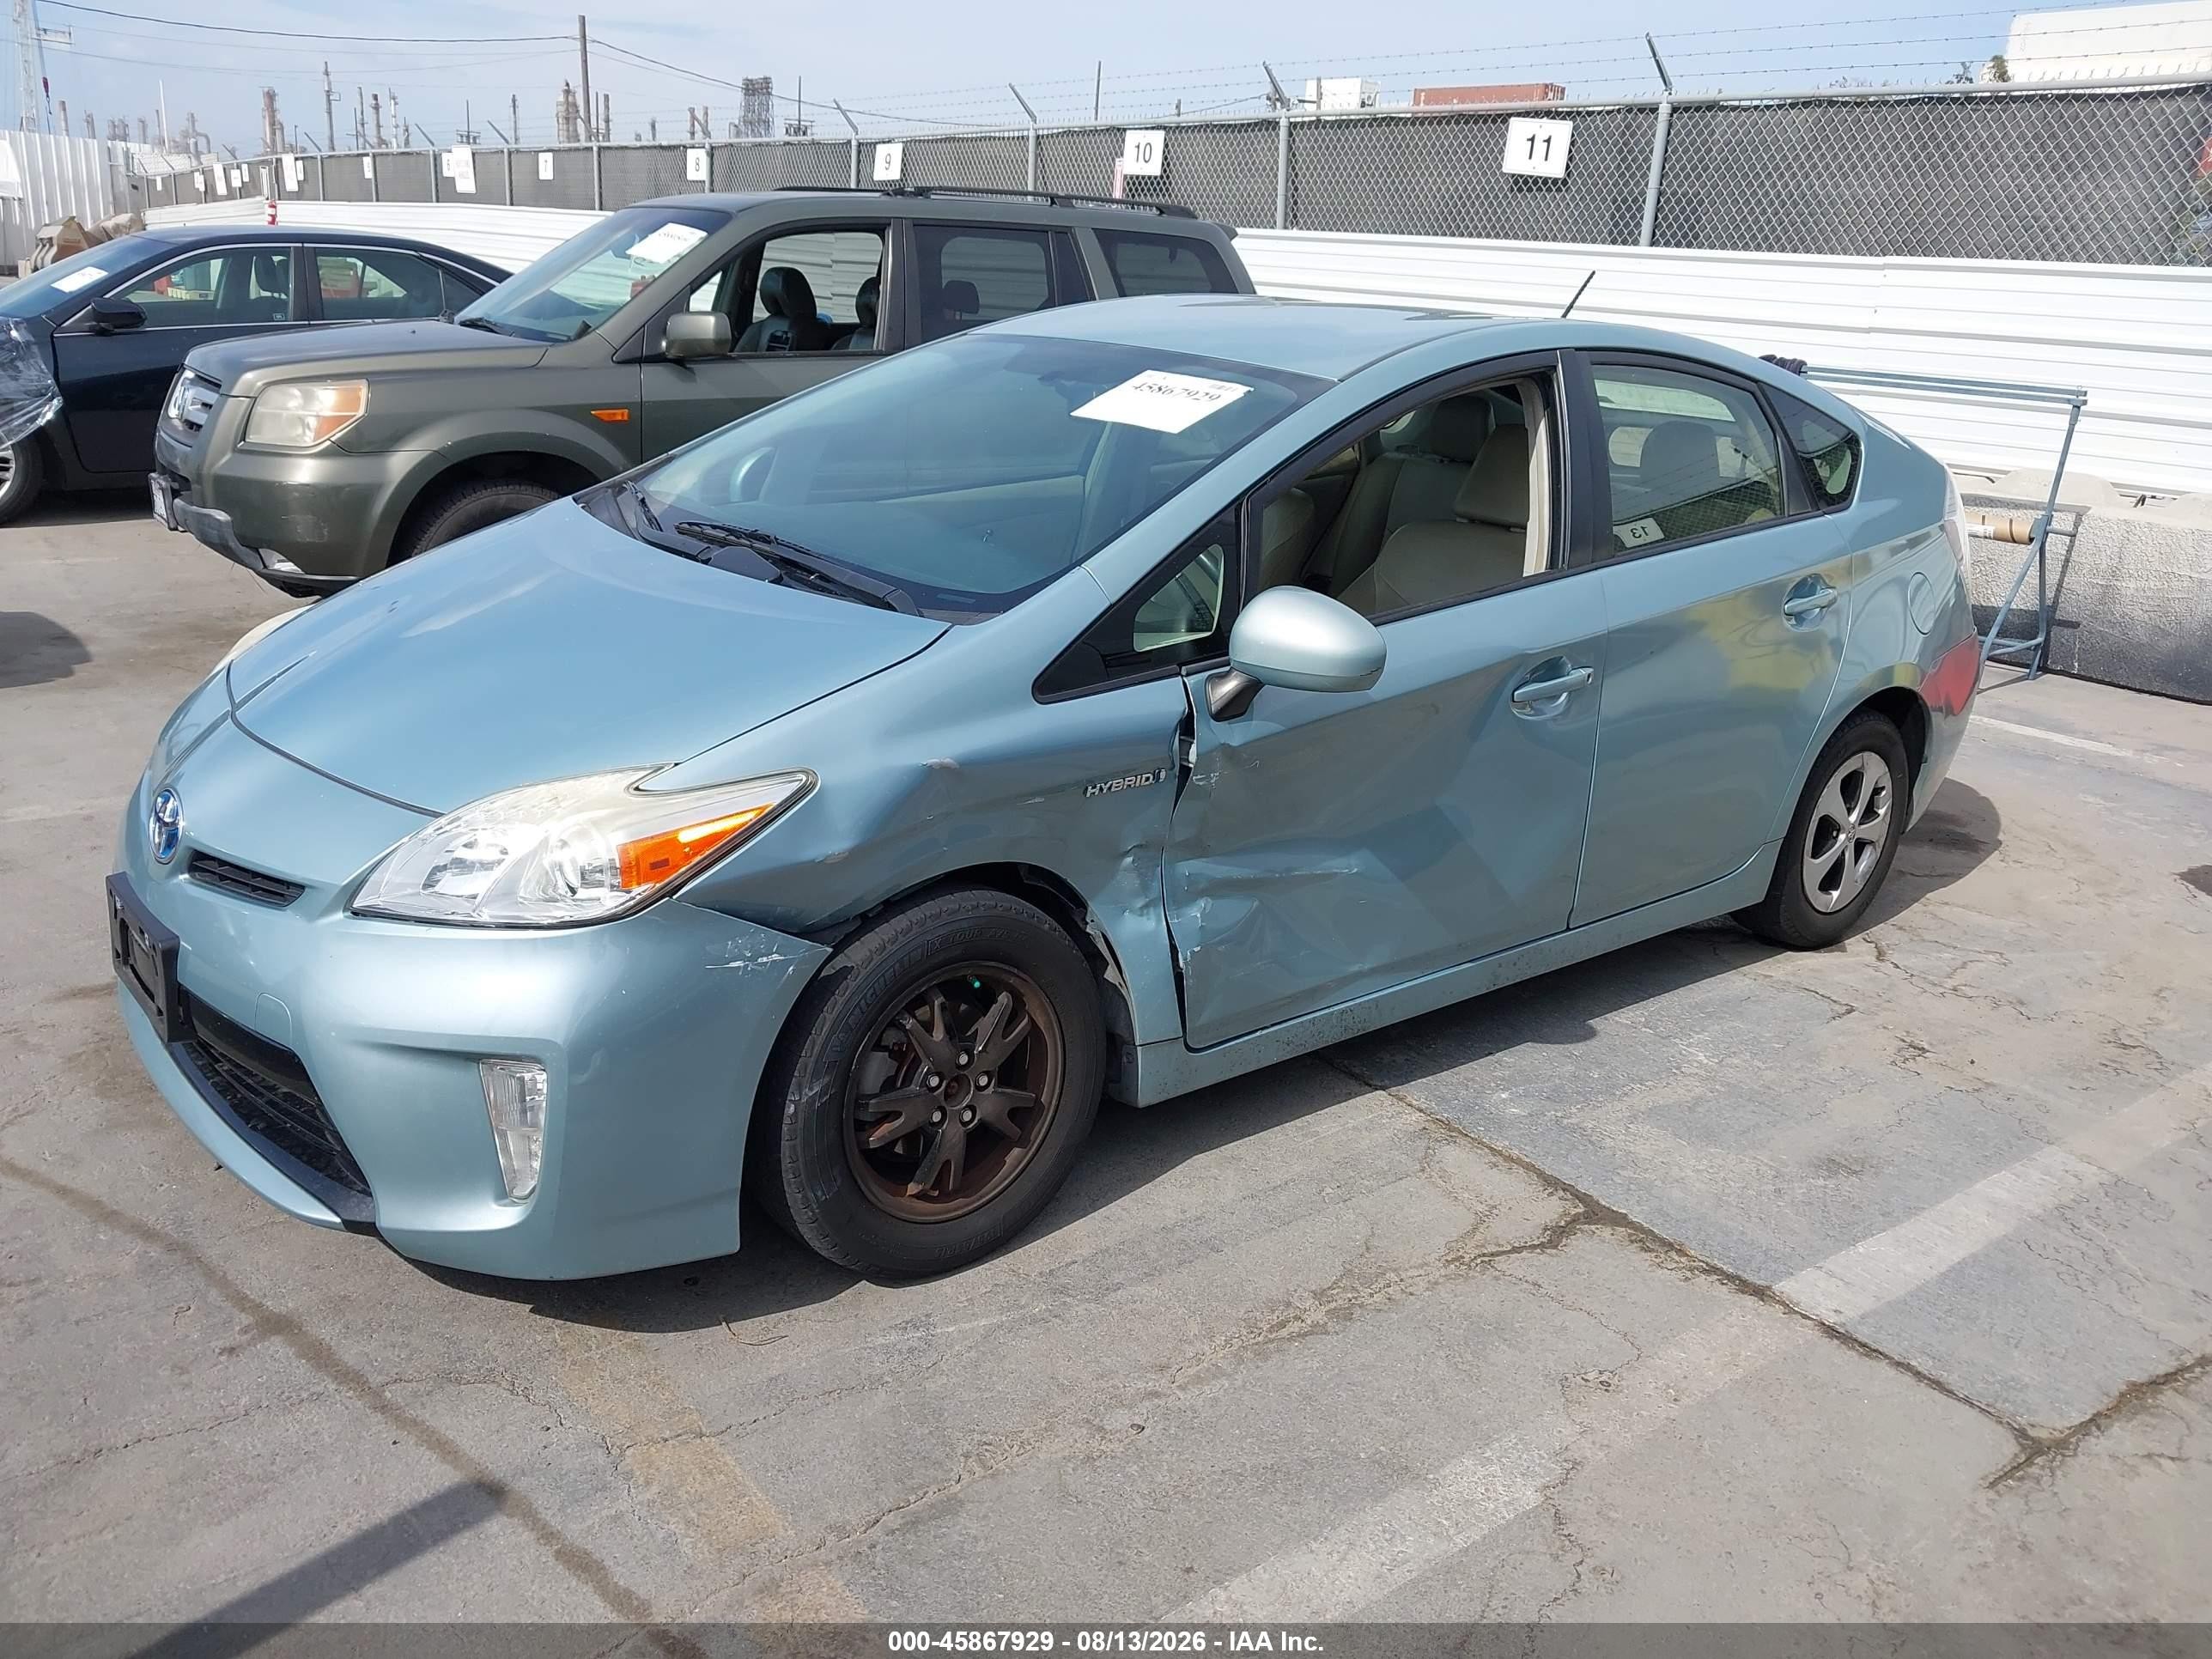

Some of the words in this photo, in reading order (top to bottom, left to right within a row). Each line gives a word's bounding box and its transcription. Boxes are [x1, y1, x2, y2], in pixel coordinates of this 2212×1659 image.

[1134, 142, 1152, 163] 10
[1526, 133, 1553, 161] 11
[695, 157, 701, 172] 8
[884, 153, 891, 170] 9
[1133, 381, 1221, 403] 45867929
[1085, 773, 1155, 798] HYBRID
